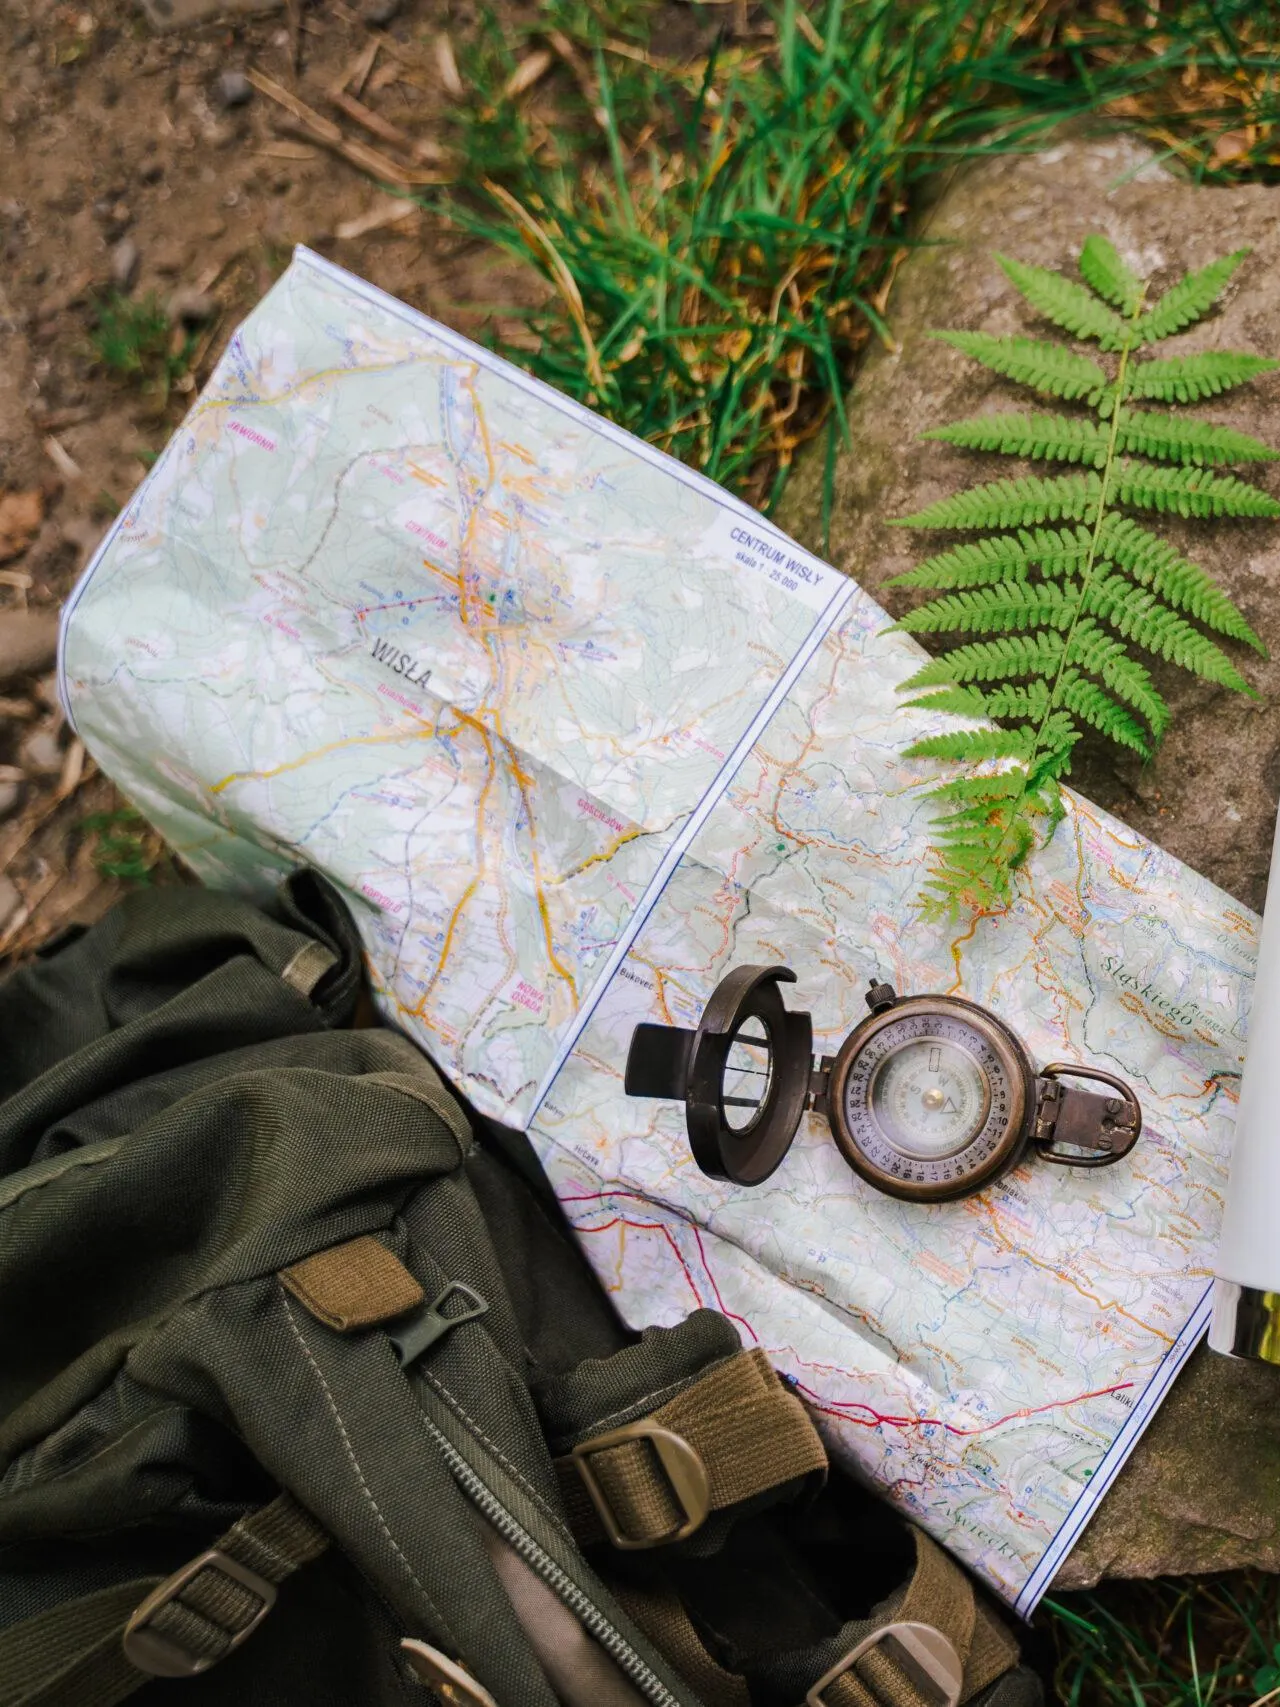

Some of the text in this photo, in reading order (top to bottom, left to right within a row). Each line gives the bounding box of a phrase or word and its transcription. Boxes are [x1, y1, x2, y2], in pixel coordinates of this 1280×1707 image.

[730, 527, 786, 566] CENTRUM
[371, 637, 432, 689] WISŁA
[619, 967, 655, 991] Bukovec
[1110, 1389, 1135, 1408] Laliki
